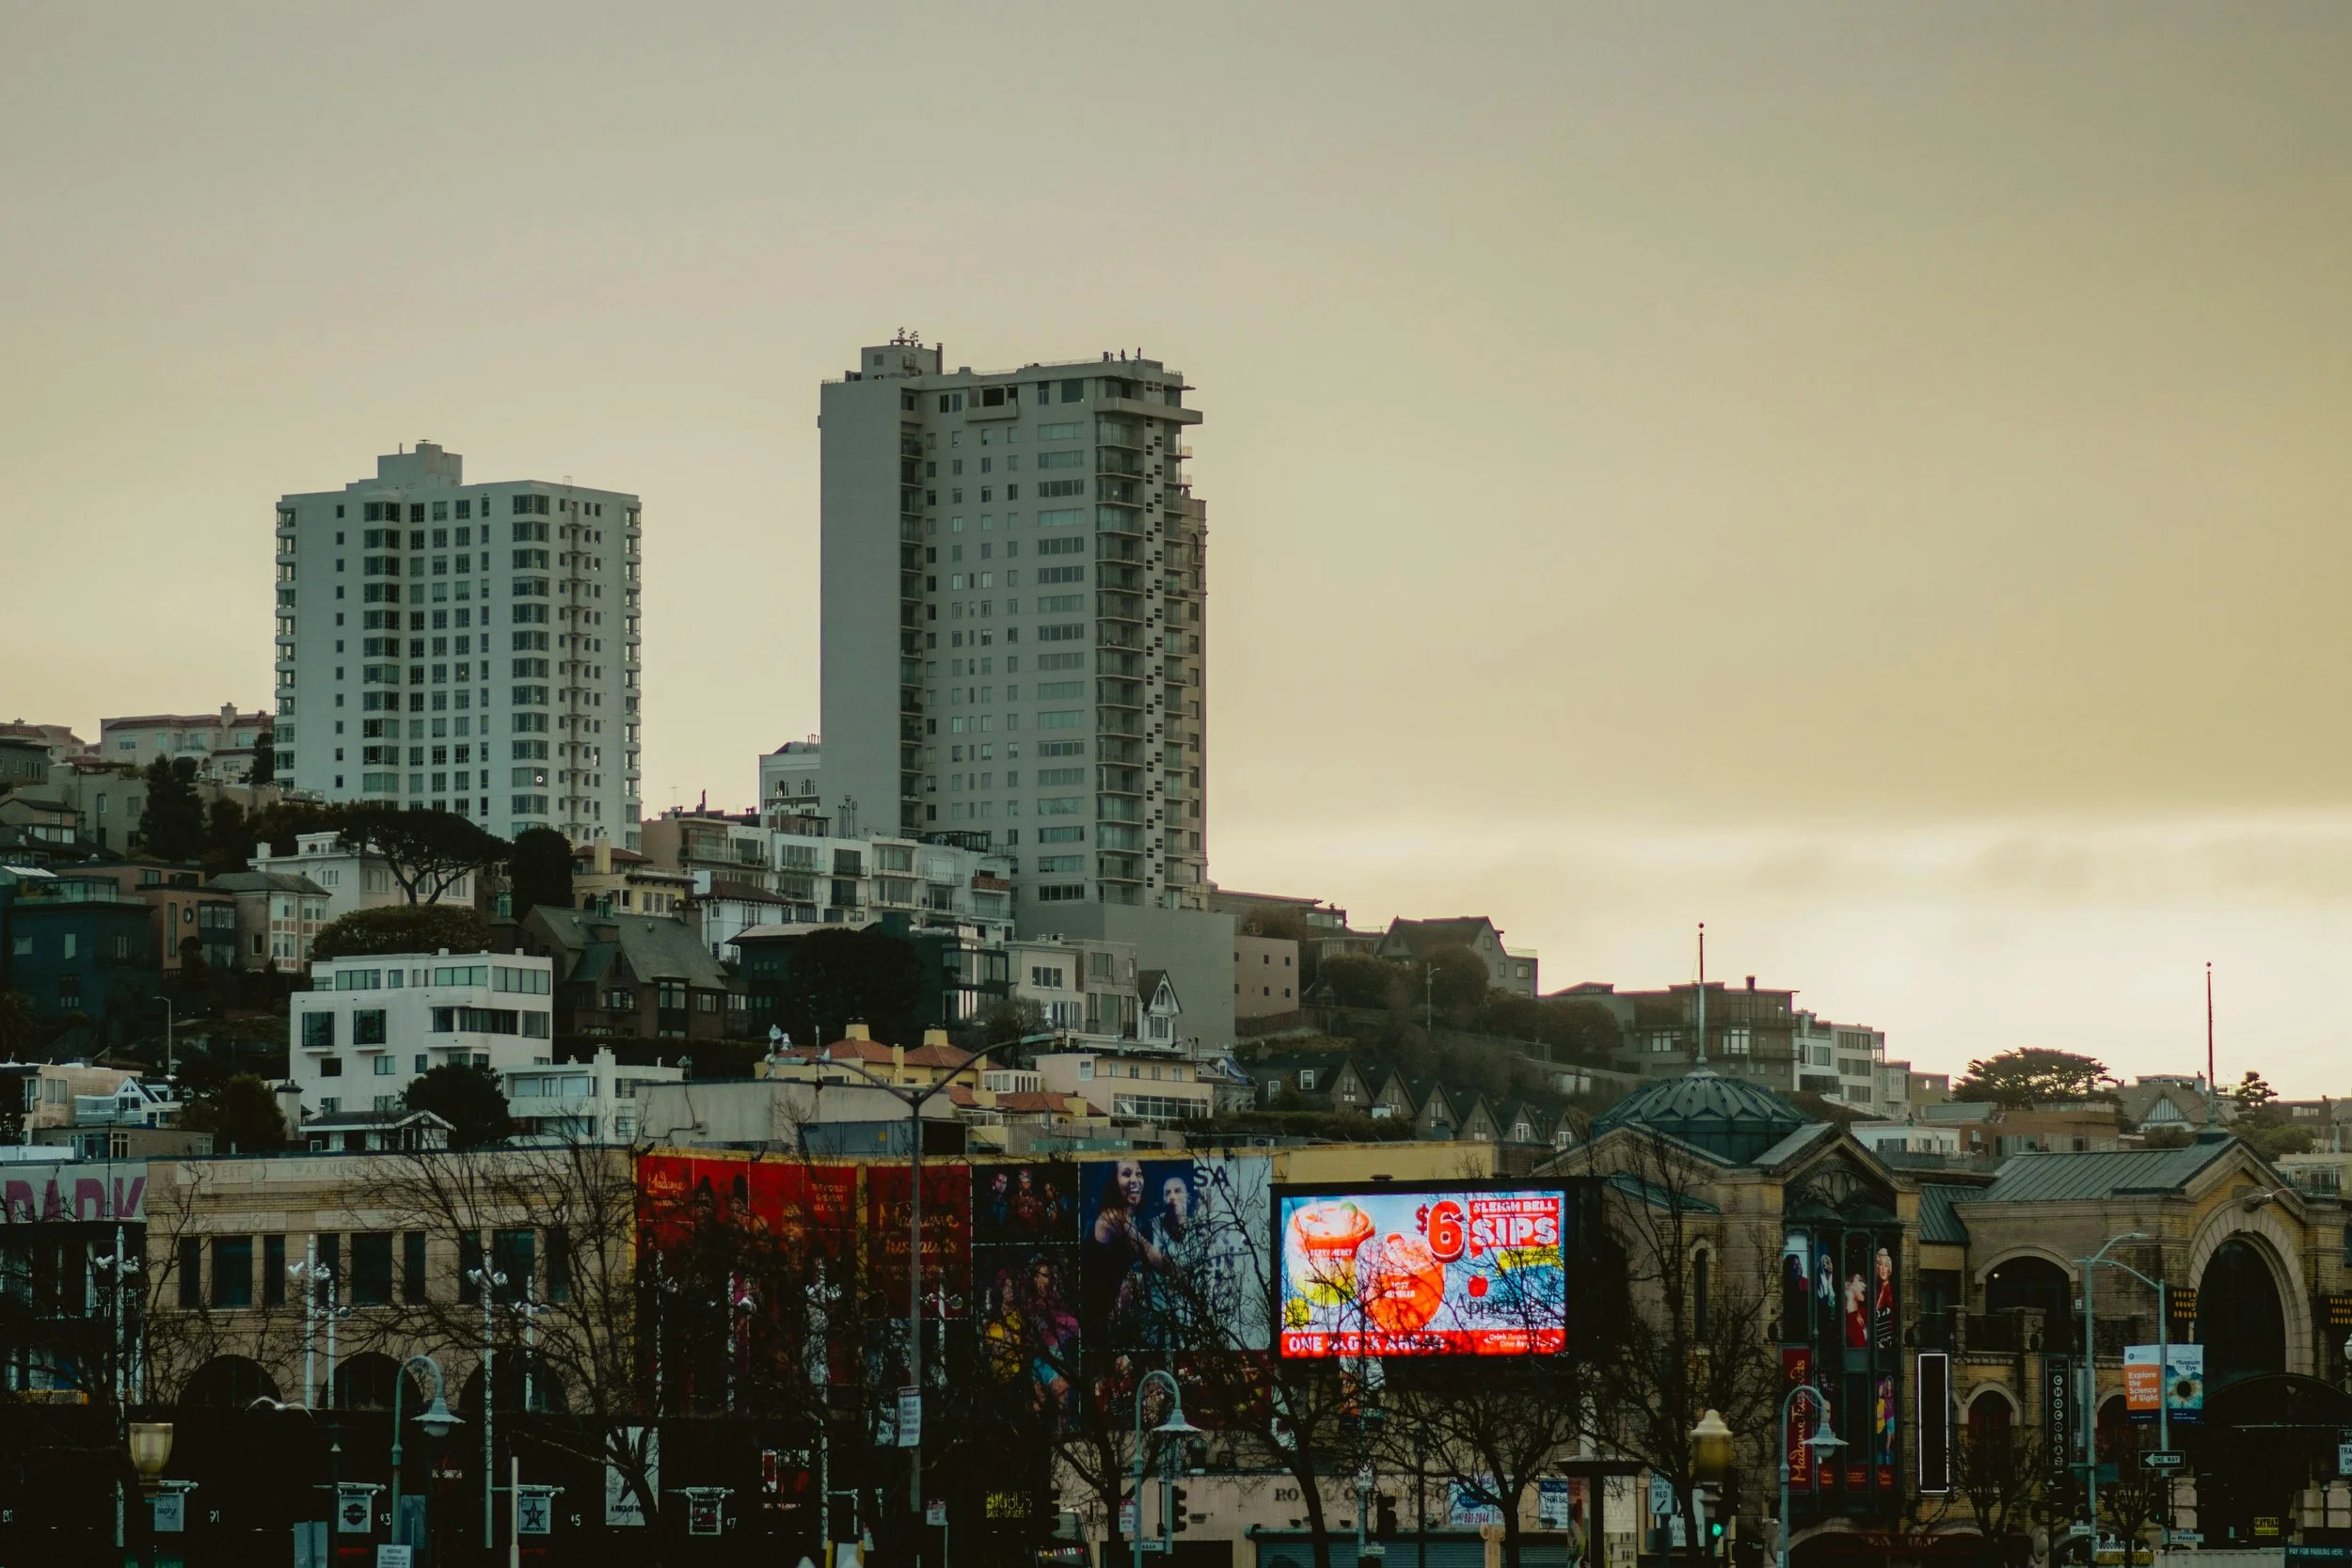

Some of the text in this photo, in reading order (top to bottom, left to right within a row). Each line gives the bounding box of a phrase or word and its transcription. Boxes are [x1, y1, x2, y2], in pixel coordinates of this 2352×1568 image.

[1472, 1199, 1556, 1213] SLEIGH BELL
[1415, 1200, 1465, 1262] $6
[1471, 1217, 1558, 1245] SIPS
[1289, 1336, 1323, 1352] ONE
[2139, 1394, 2158, 1402] Sight
[1788, 1420, 1806, 1482] Madame
[1275, 1488, 1336, 1501] ROL
[210, 1510, 220, 1523] 91
